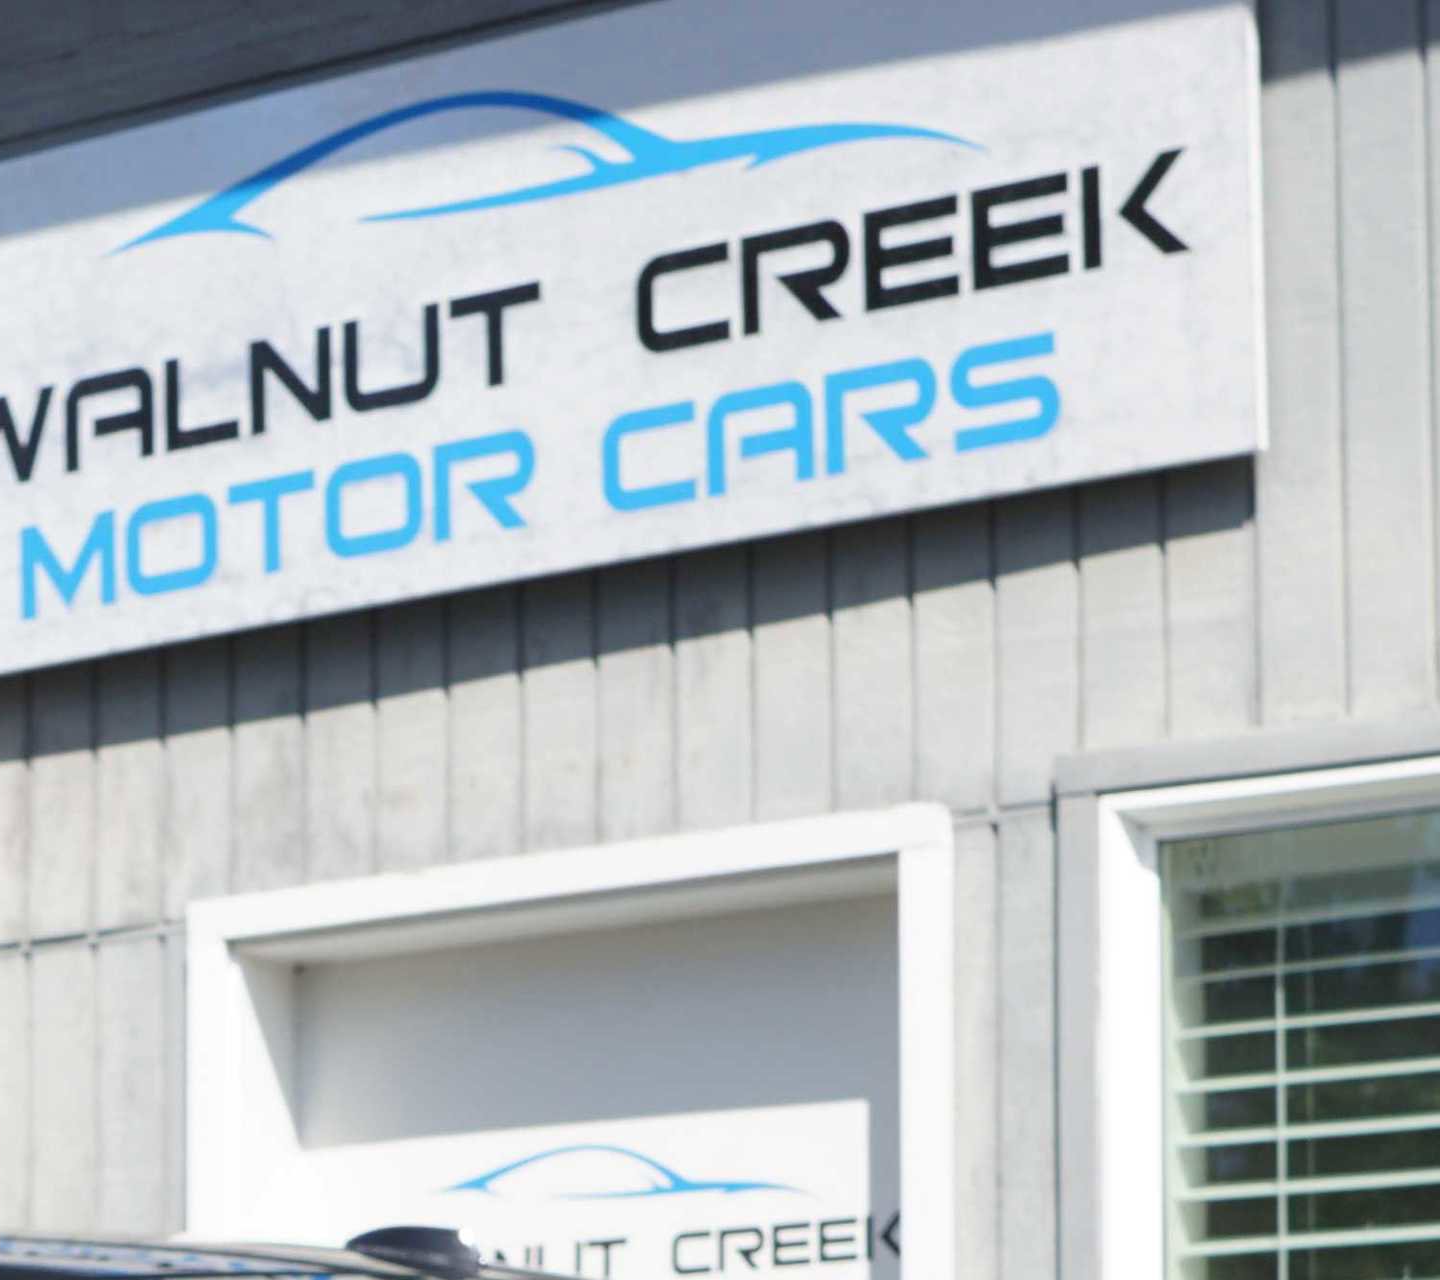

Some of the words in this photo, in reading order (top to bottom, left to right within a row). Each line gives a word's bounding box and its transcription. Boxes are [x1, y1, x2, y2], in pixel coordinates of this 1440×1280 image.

[636, 148, 1189, 352] CREEK
[20, 431, 536, 620] MOTOR
[601, 332, 1062, 513] CARS
